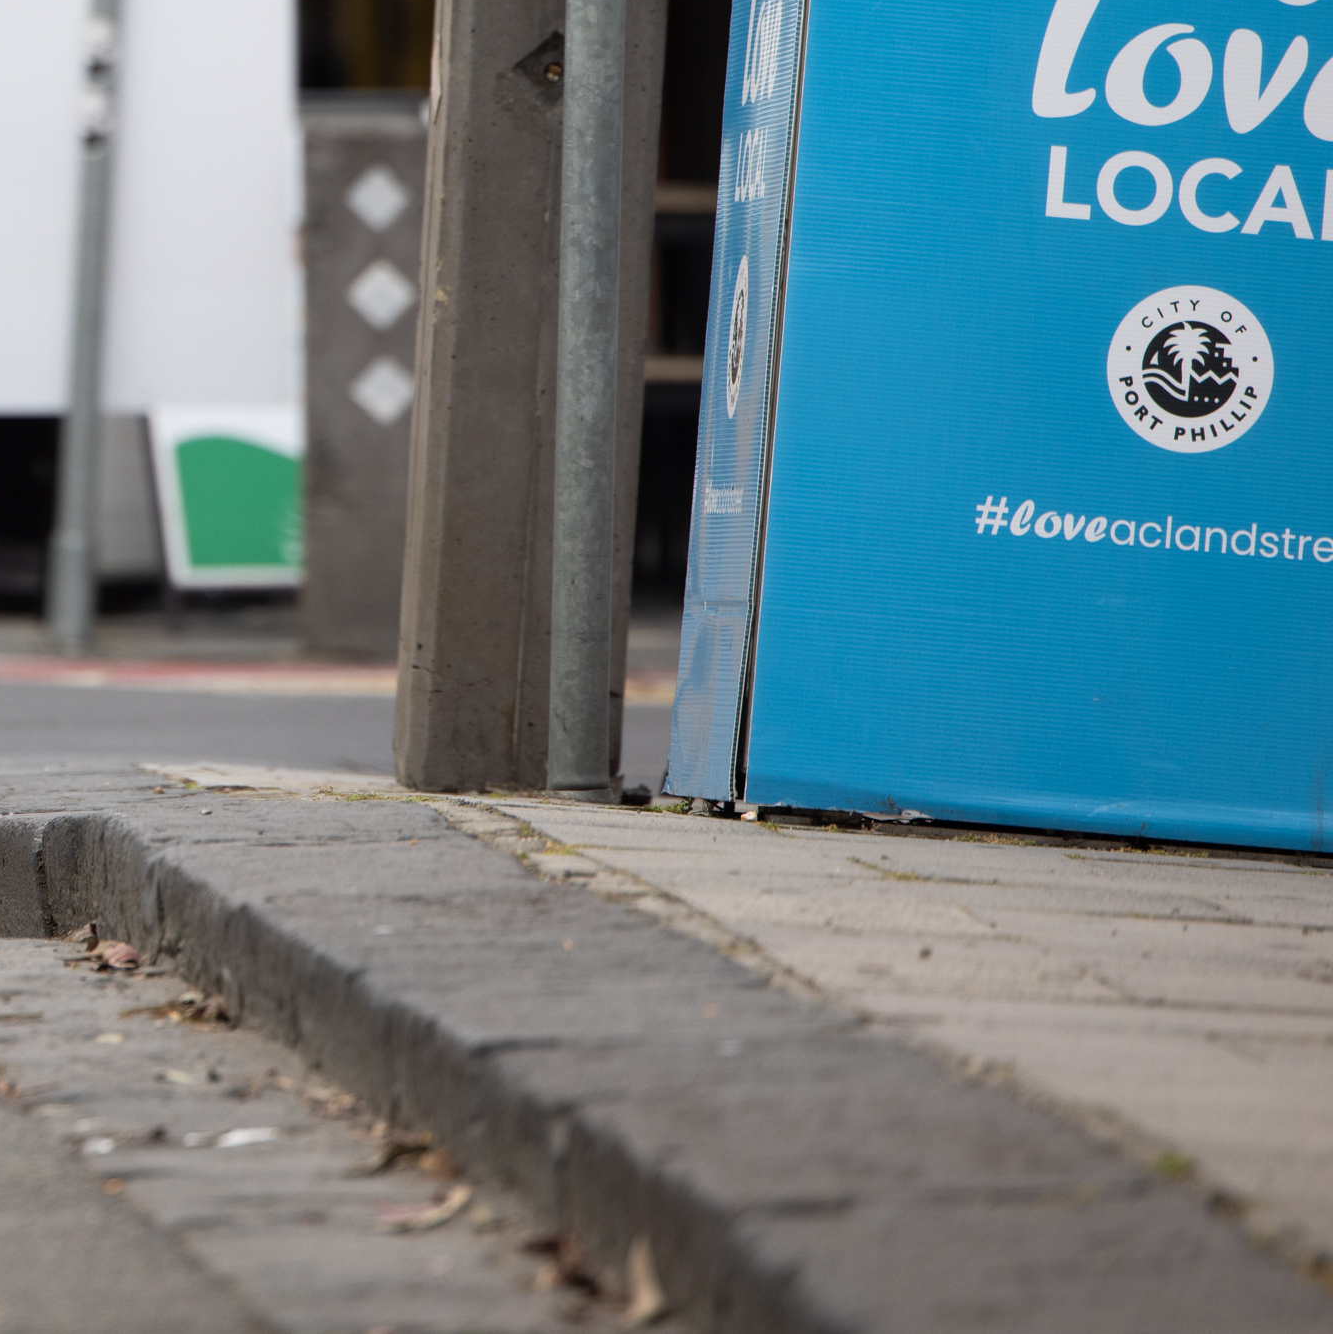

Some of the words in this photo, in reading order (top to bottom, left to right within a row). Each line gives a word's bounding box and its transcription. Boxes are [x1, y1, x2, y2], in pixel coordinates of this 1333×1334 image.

[1141, 299, 1200, 329] CITY
[1221, 310, 1247, 335] OF
[1119, 375, 1163, 431] PORT
[1173, 385, 1258, 442] PHILLIP
